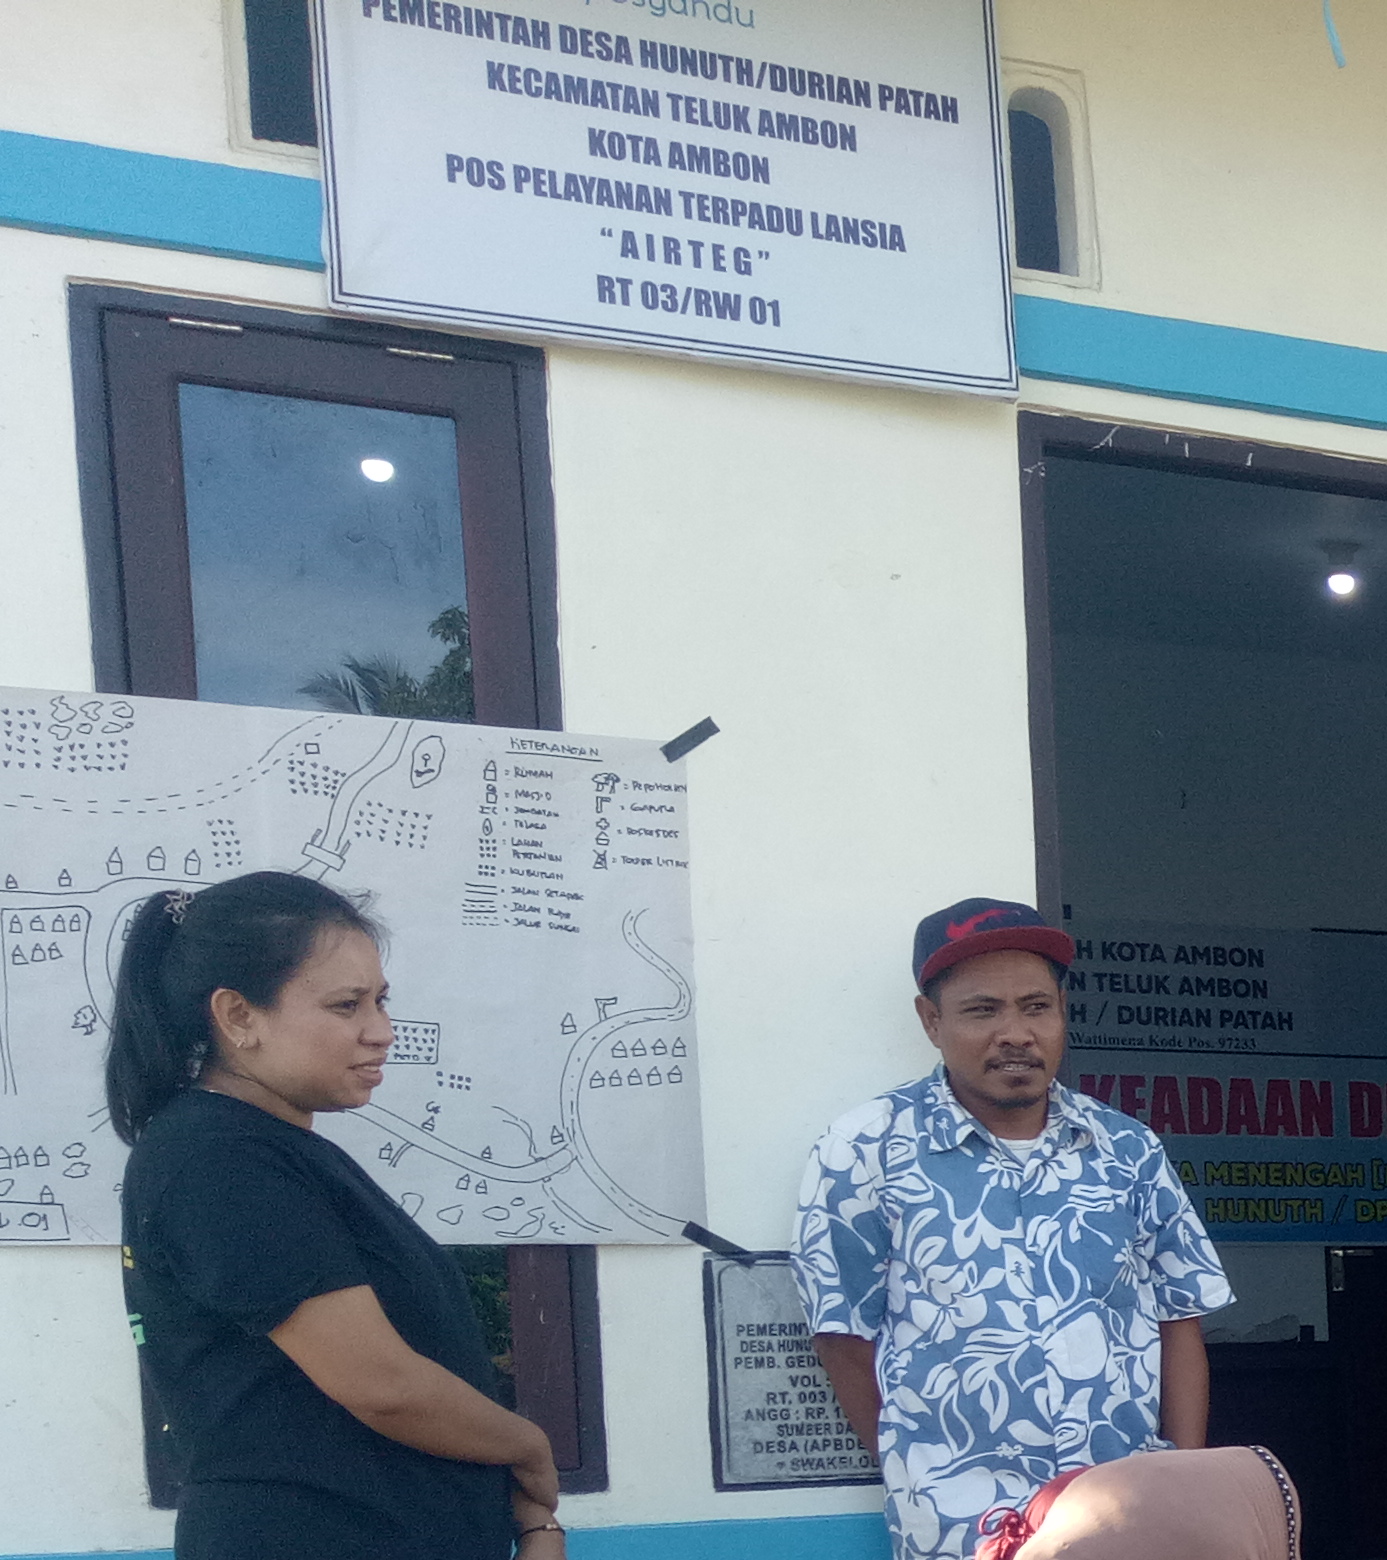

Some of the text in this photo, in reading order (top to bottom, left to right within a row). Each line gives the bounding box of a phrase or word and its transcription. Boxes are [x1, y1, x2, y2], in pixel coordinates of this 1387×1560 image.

[585, 0, 755, 29] yandu
[362, 0, 959, 124] PEMERINTAH DESA HUNUTH/DURIAN PATAH
[486, 59, 857, 153] KECAMATAN TELUK AMBON
[588, 126, 770, 185] KOTA AMBON
[446, 153, 907, 253] POS PELAYANAN TERPADU LANSIA
[596, 274, 781, 328] RT 03/RW 01
[1101, 941, 1167, 964] KOTA
[1174, 944, 1265, 968] AMBON
[1091, 971, 1171, 995] TELUK
[1178, 975, 1268, 999] AMBON
[1117, 1005, 1212, 1028] DURIAN
[1219, 1009, 1293, 1032] PATAH
[1204, 1161, 1364, 1188] MENENGAH
[1205, 1197, 1324, 1224] HUNUTH
[740, 1340, 774, 1353] DESA
[734, 1356, 780, 1370] PEMB.
[788, 1375, 821, 1388] VOL
[766, 1392, 792, 1405] RT.
[798, 1390, 828, 1404] 003
[744, 1408, 791, 1421] ANGG
[777, 1422, 832, 1437] SUMBER
[753, 1440, 800, 1454] DESA
